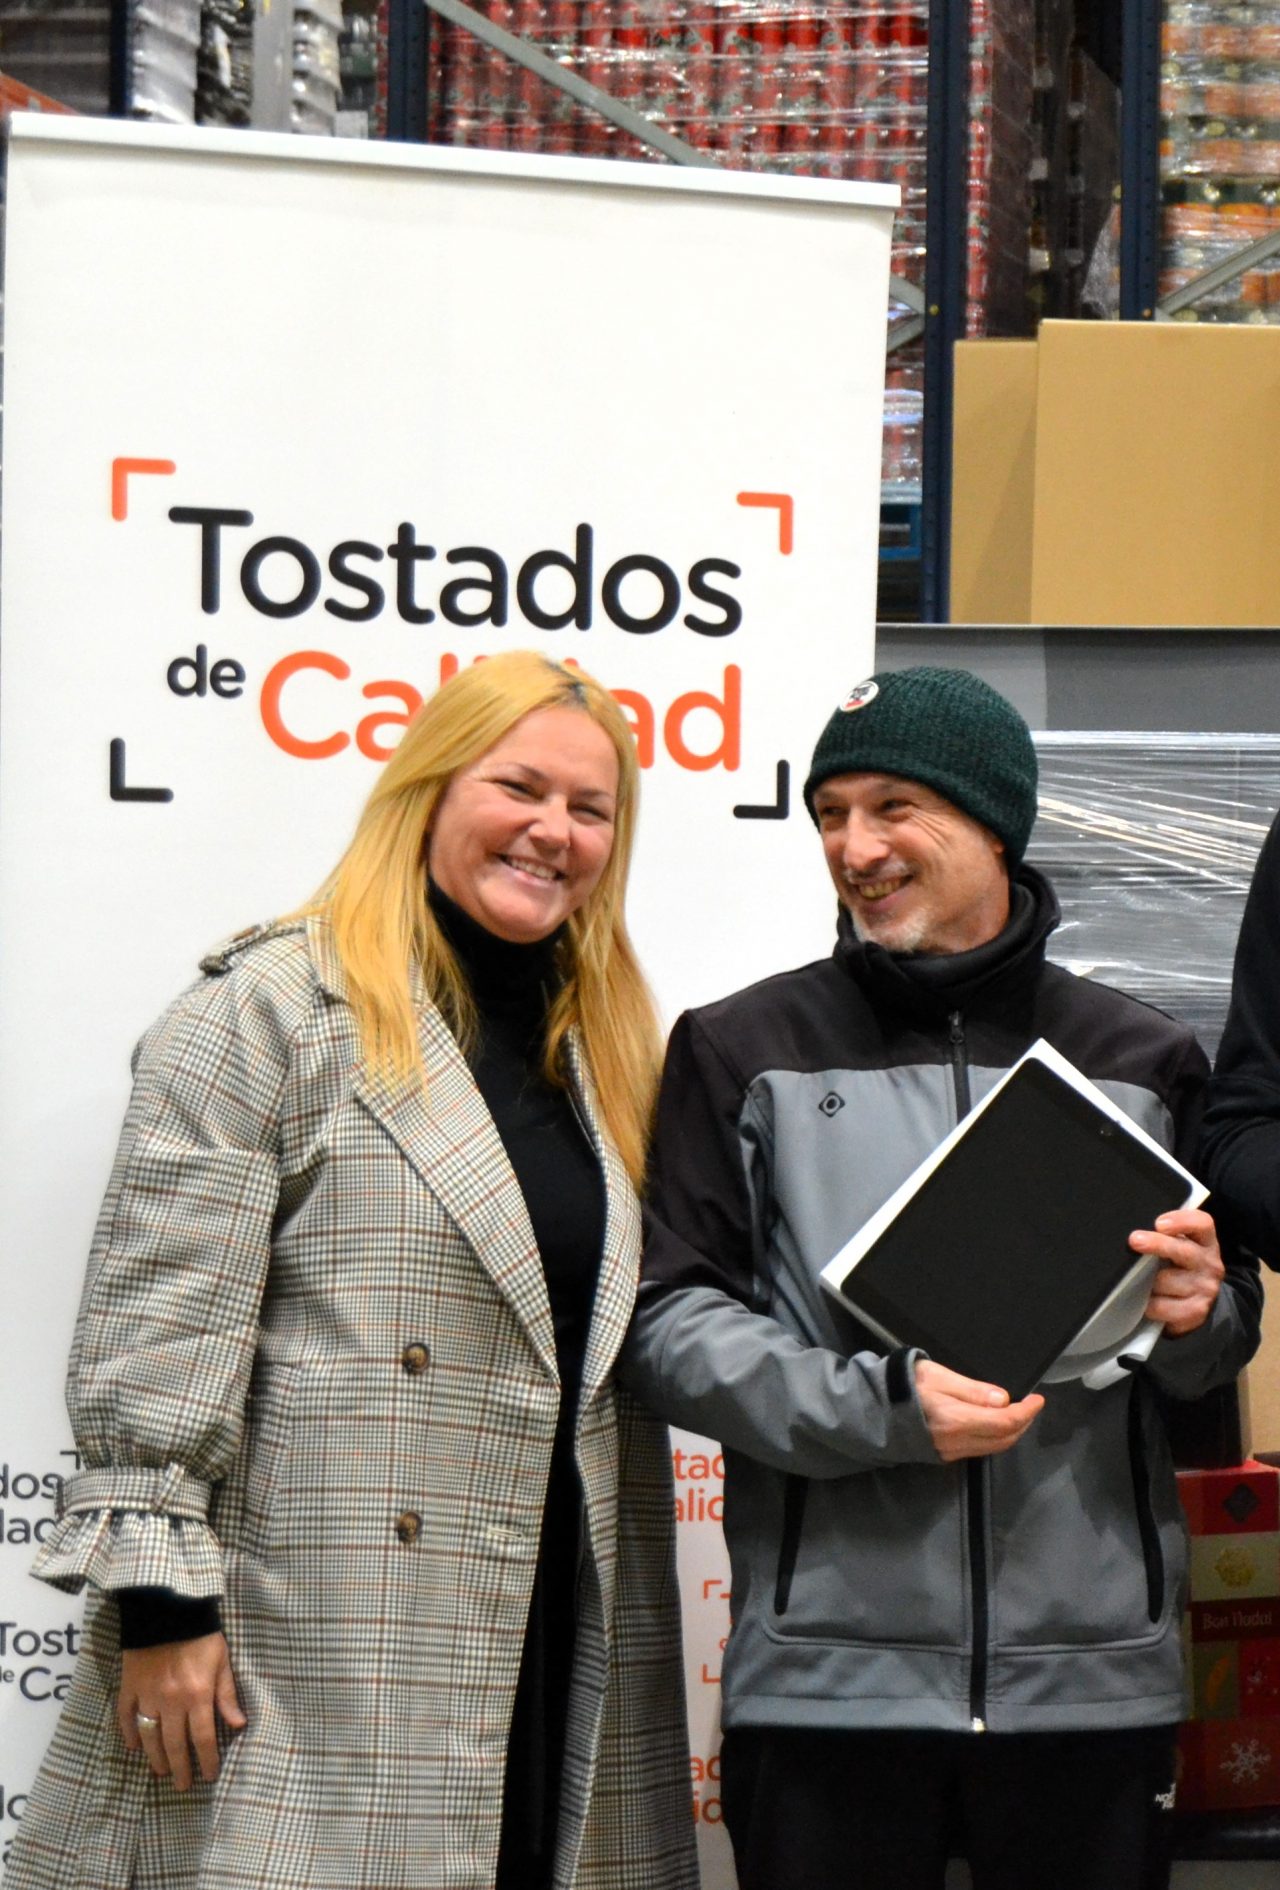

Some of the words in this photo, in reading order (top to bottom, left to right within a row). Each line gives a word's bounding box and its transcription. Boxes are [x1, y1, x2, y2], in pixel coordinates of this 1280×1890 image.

[168, 507, 743, 637] Tostados
[167, 643, 246, 698] de
[260, 650, 742, 772] Caad
